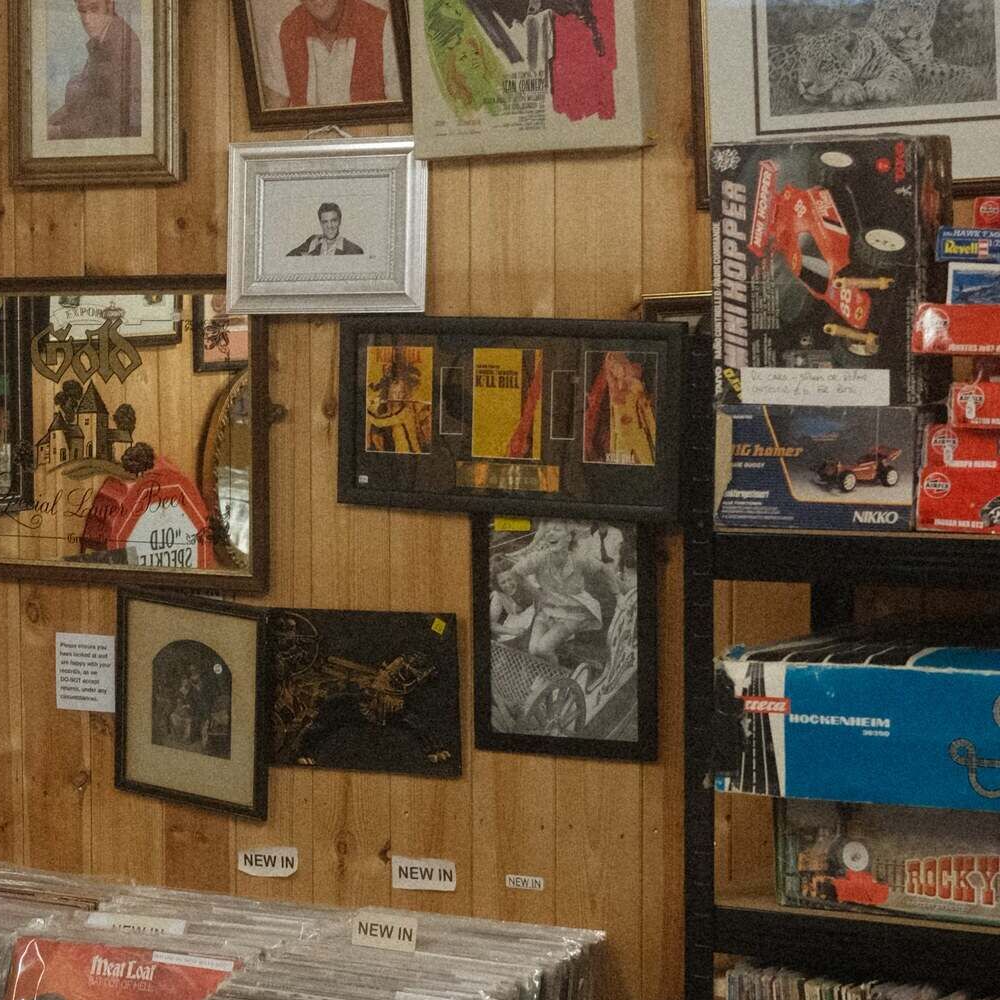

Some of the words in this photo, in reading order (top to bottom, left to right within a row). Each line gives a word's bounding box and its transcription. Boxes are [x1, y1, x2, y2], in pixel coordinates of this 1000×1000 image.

[722, 180, 748, 302] HOPPER
[954, 229, 980, 238] HAWK
[722, 302, 748, 369] MINI
[852, 510, 899, 525] NIKKO
[789, 713, 891, 728] HOCKENHEIM
[243, 853, 277, 868] NEW
[281, 856, 295, 870] IN
[398, 865, 434, 882] NEW
[438, 868, 453, 883] IN
[508, 876, 528, 888] NEW
[531, 878, 541, 889] IN
[905, 853, 1000, 907] ROCKY
[357, 921, 394, 939] NEW
[398, 927, 413, 942] IN
[90, 954, 124, 977] Meat
[126, 960, 156, 982] Loaf
